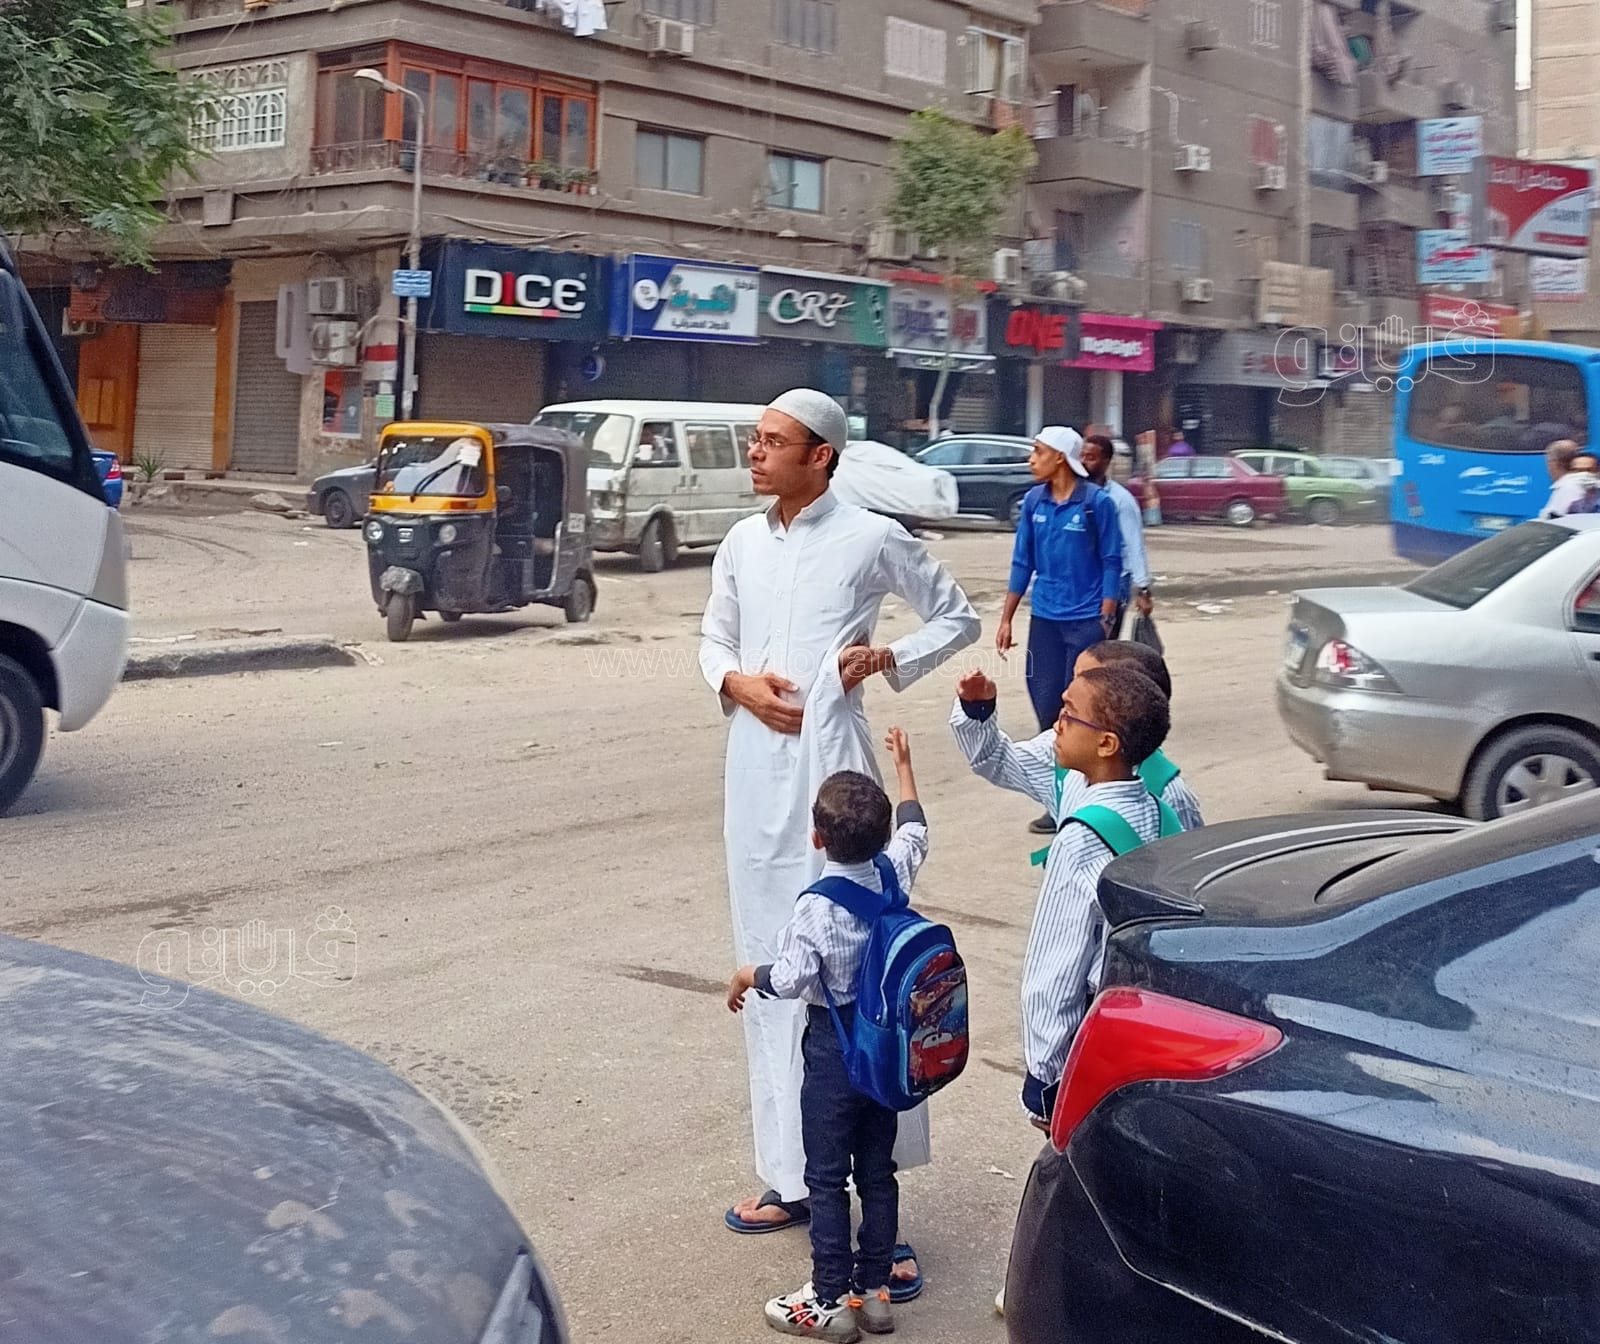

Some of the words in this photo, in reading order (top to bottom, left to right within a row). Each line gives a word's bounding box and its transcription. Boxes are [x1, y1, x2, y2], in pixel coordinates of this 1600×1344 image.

[464, 268, 587, 312] DICE
[767, 289, 857, 328] CR7
[1006, 309, 1069, 353] ONE
